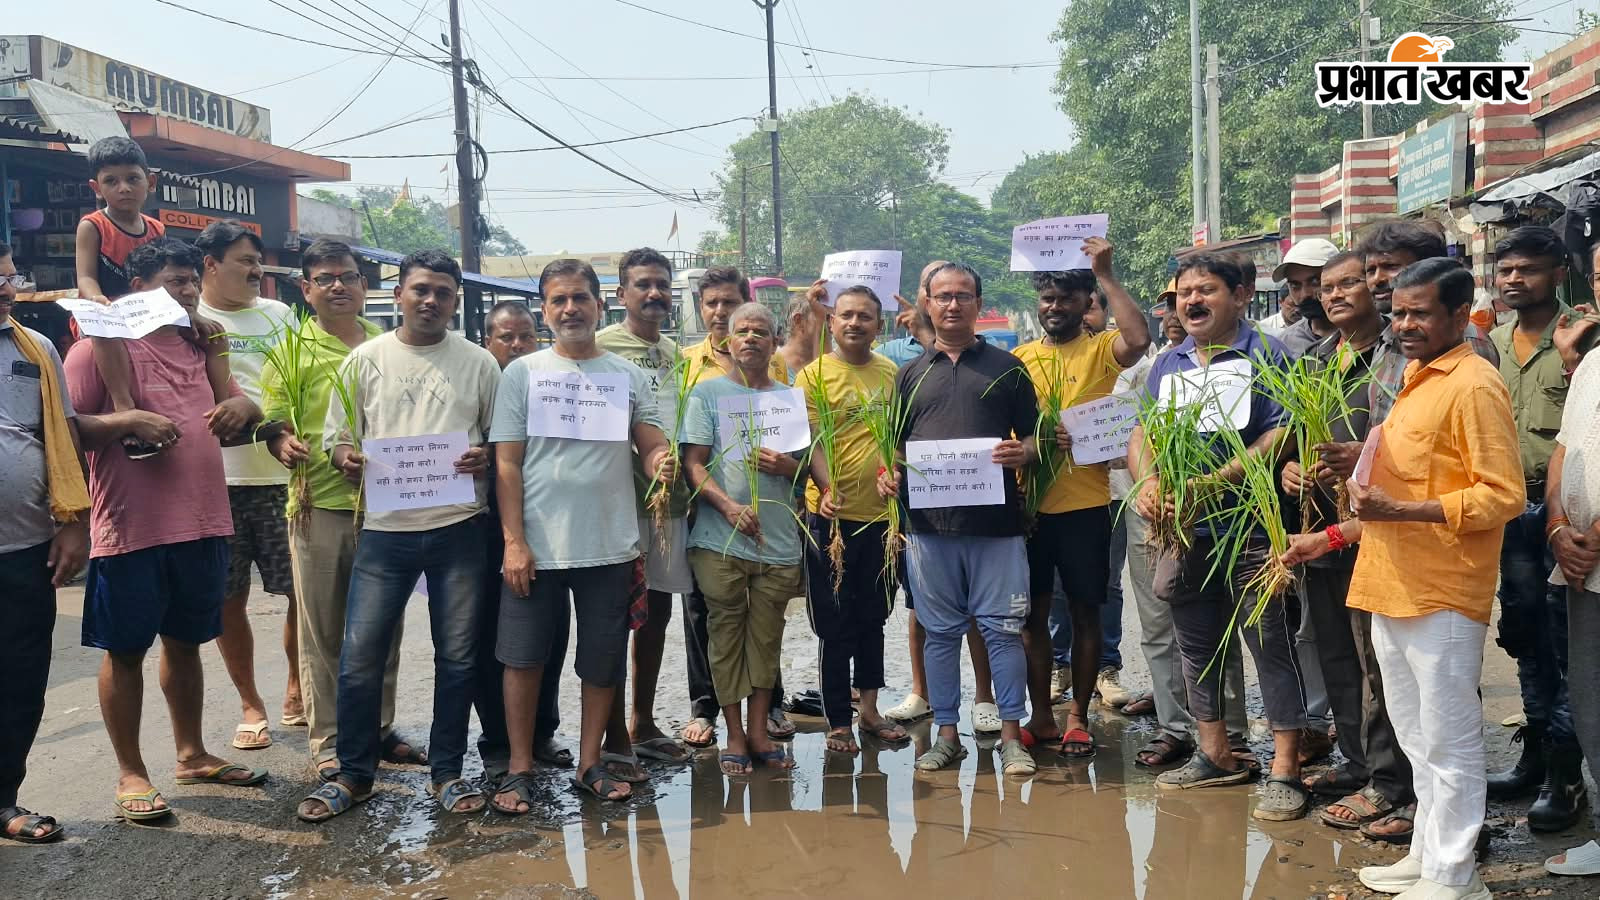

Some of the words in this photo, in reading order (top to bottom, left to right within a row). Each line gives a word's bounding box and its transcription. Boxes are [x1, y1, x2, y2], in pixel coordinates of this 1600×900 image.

[105, 60, 235, 131] MUMBAI
[560, 413, 576, 423] करो
[429, 443, 449, 451] निगम
[427, 474, 448, 482] निगम
[930, 483, 951, 493] निगम
